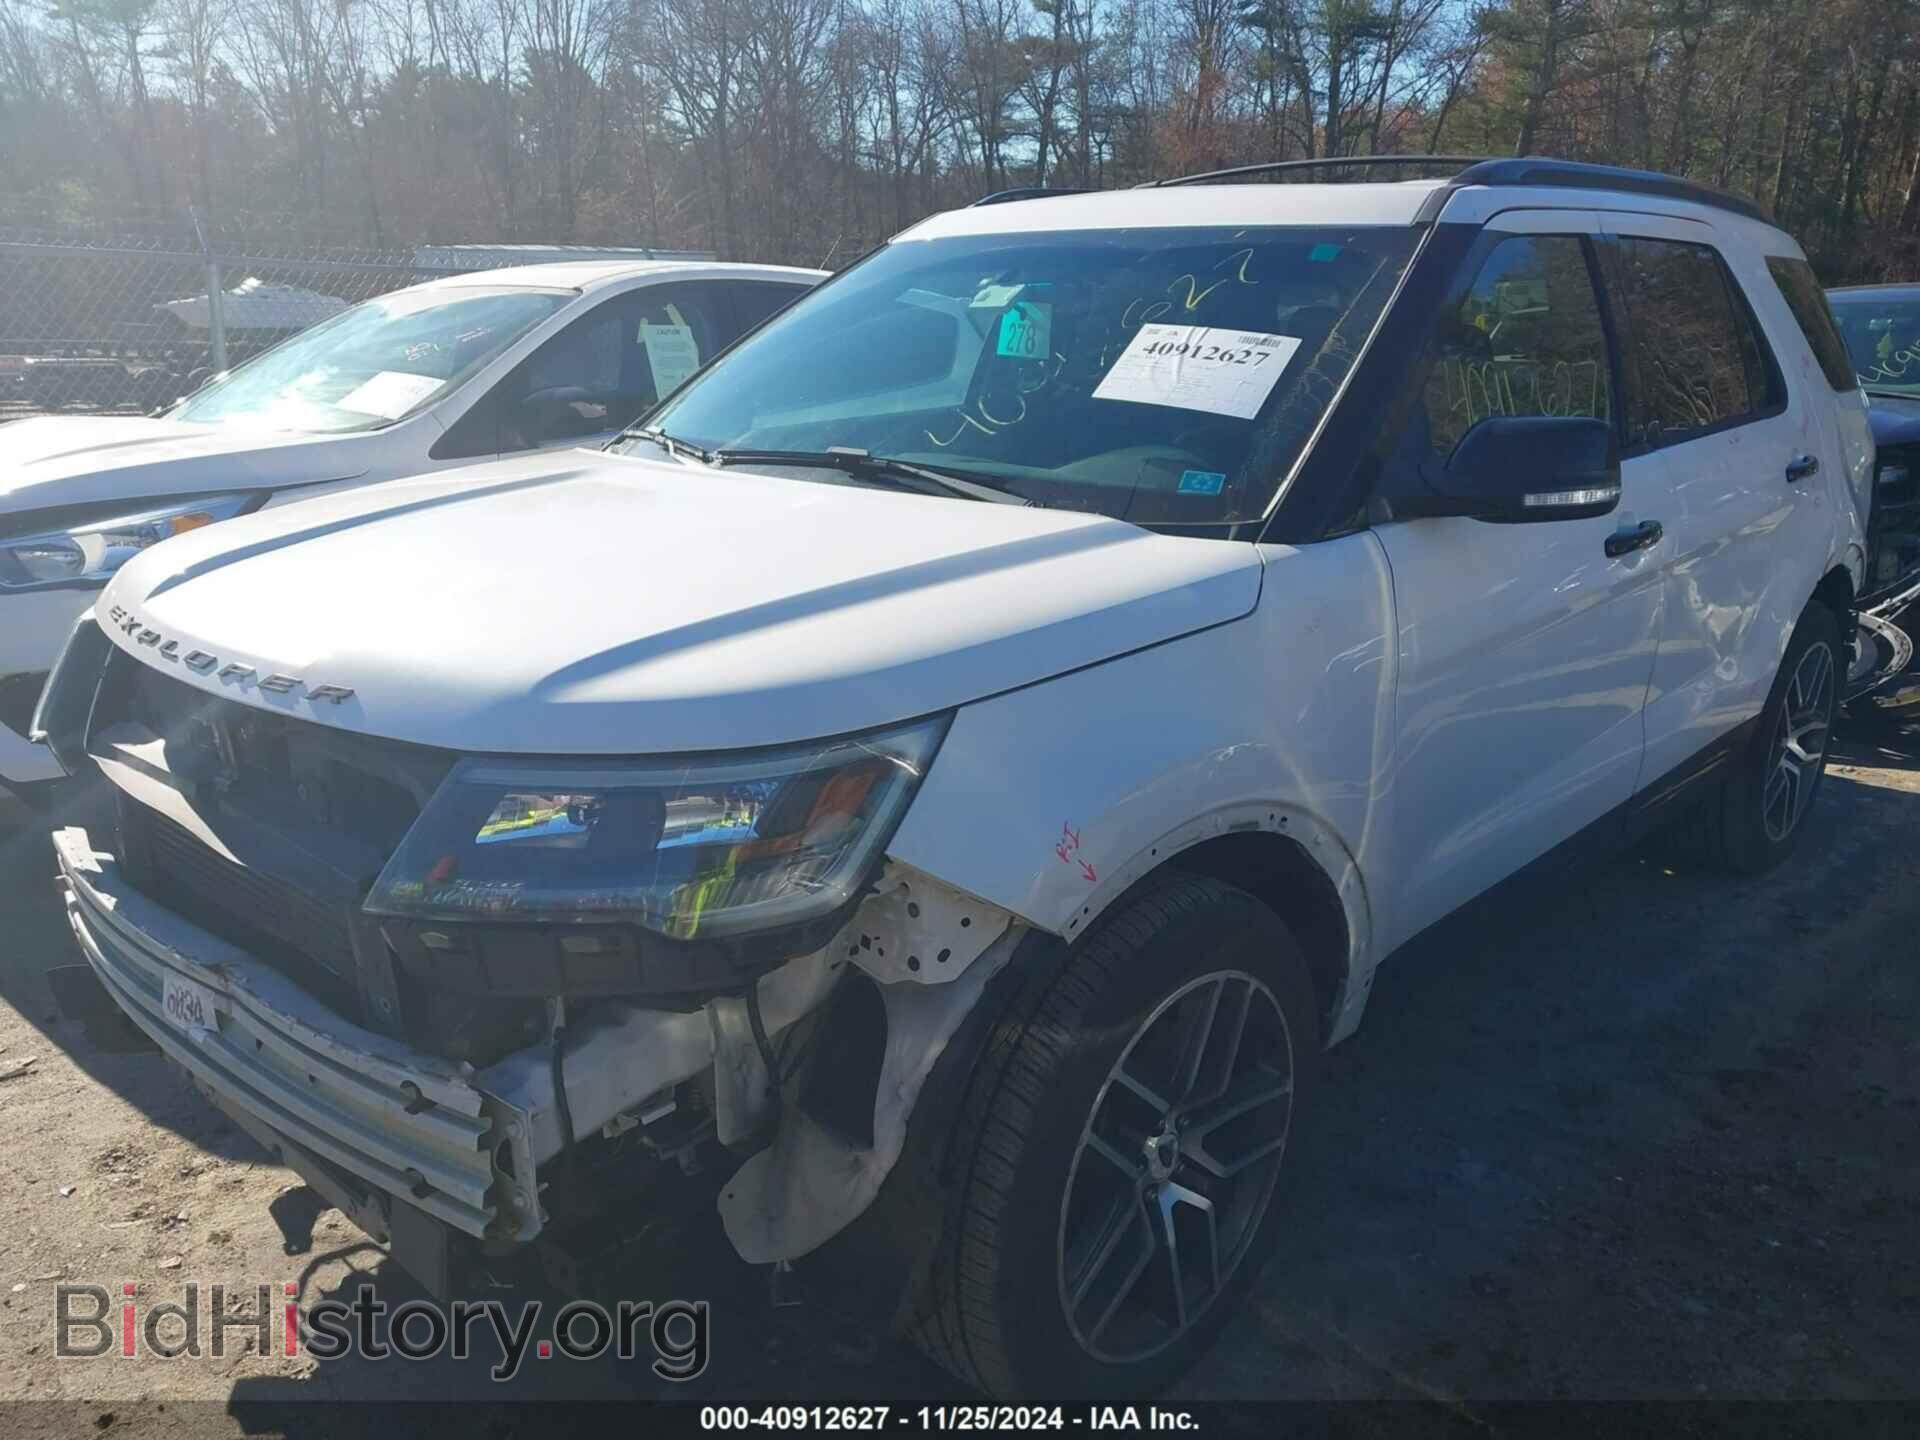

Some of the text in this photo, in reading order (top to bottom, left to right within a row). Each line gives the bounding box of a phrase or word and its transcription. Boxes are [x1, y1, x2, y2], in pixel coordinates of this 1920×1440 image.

[1006, 320, 1037, 355] 278
[1142, 340, 1271, 367] 40912627
[108, 604, 355, 705] EXPLORER
